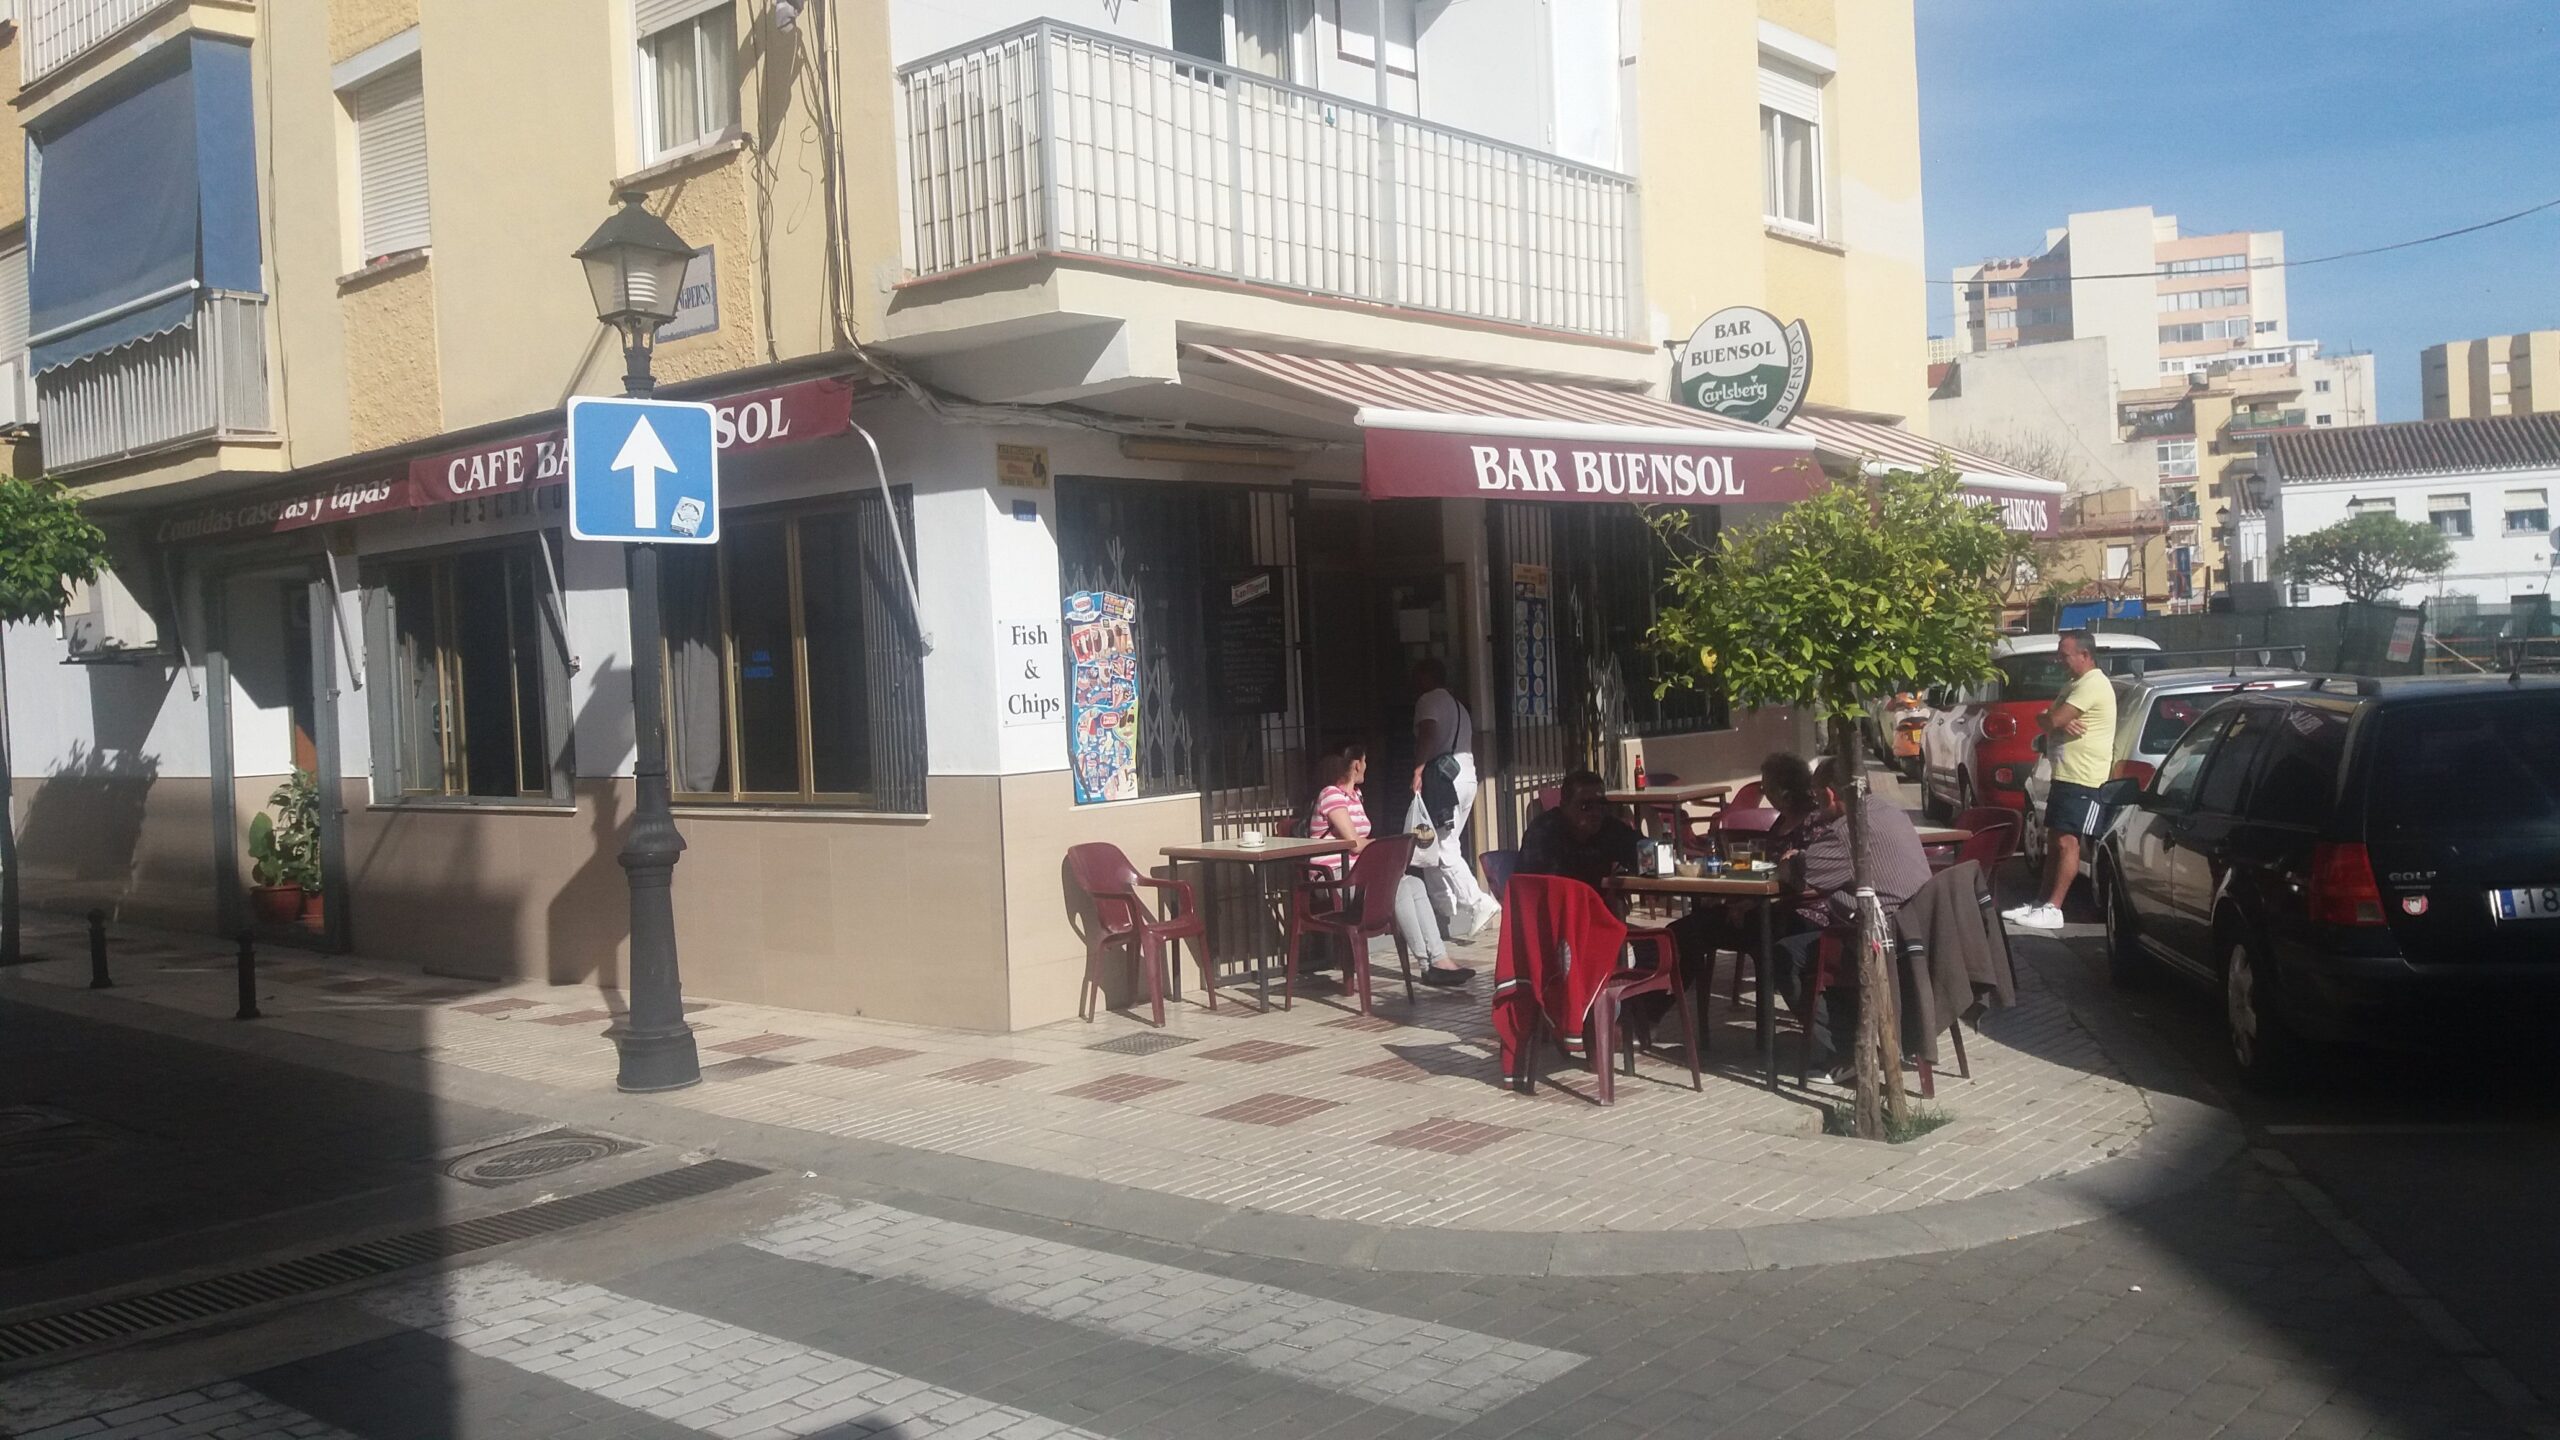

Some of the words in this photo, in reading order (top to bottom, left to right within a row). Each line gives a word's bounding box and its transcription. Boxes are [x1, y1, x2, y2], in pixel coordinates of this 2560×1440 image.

[1714, 320, 1751, 339] BAR
[1691, 341, 1776, 366] BUENSOL
[1777, 329, 1804, 414] BUENSOL
[1698, 381, 1767, 408] Carlsberg
[448, 446, 525, 494] CAFE
[536, 437, 568, 479] BA
[715, 397, 791, 449] SOL
[1470, 445, 1565, 492] BAR
[1572, 451, 1745, 496] BUENSOL
[157, 507, 232, 542] Comidas
[311, 489, 327, 520] y
[331, 478, 392, 513] tapas
[1011, 625, 1048, 645] Fish
[1024, 659, 1041, 679] &
[1008, 694, 1060, 720] Chips
[2388, 870, 2437, 881] GOLF
